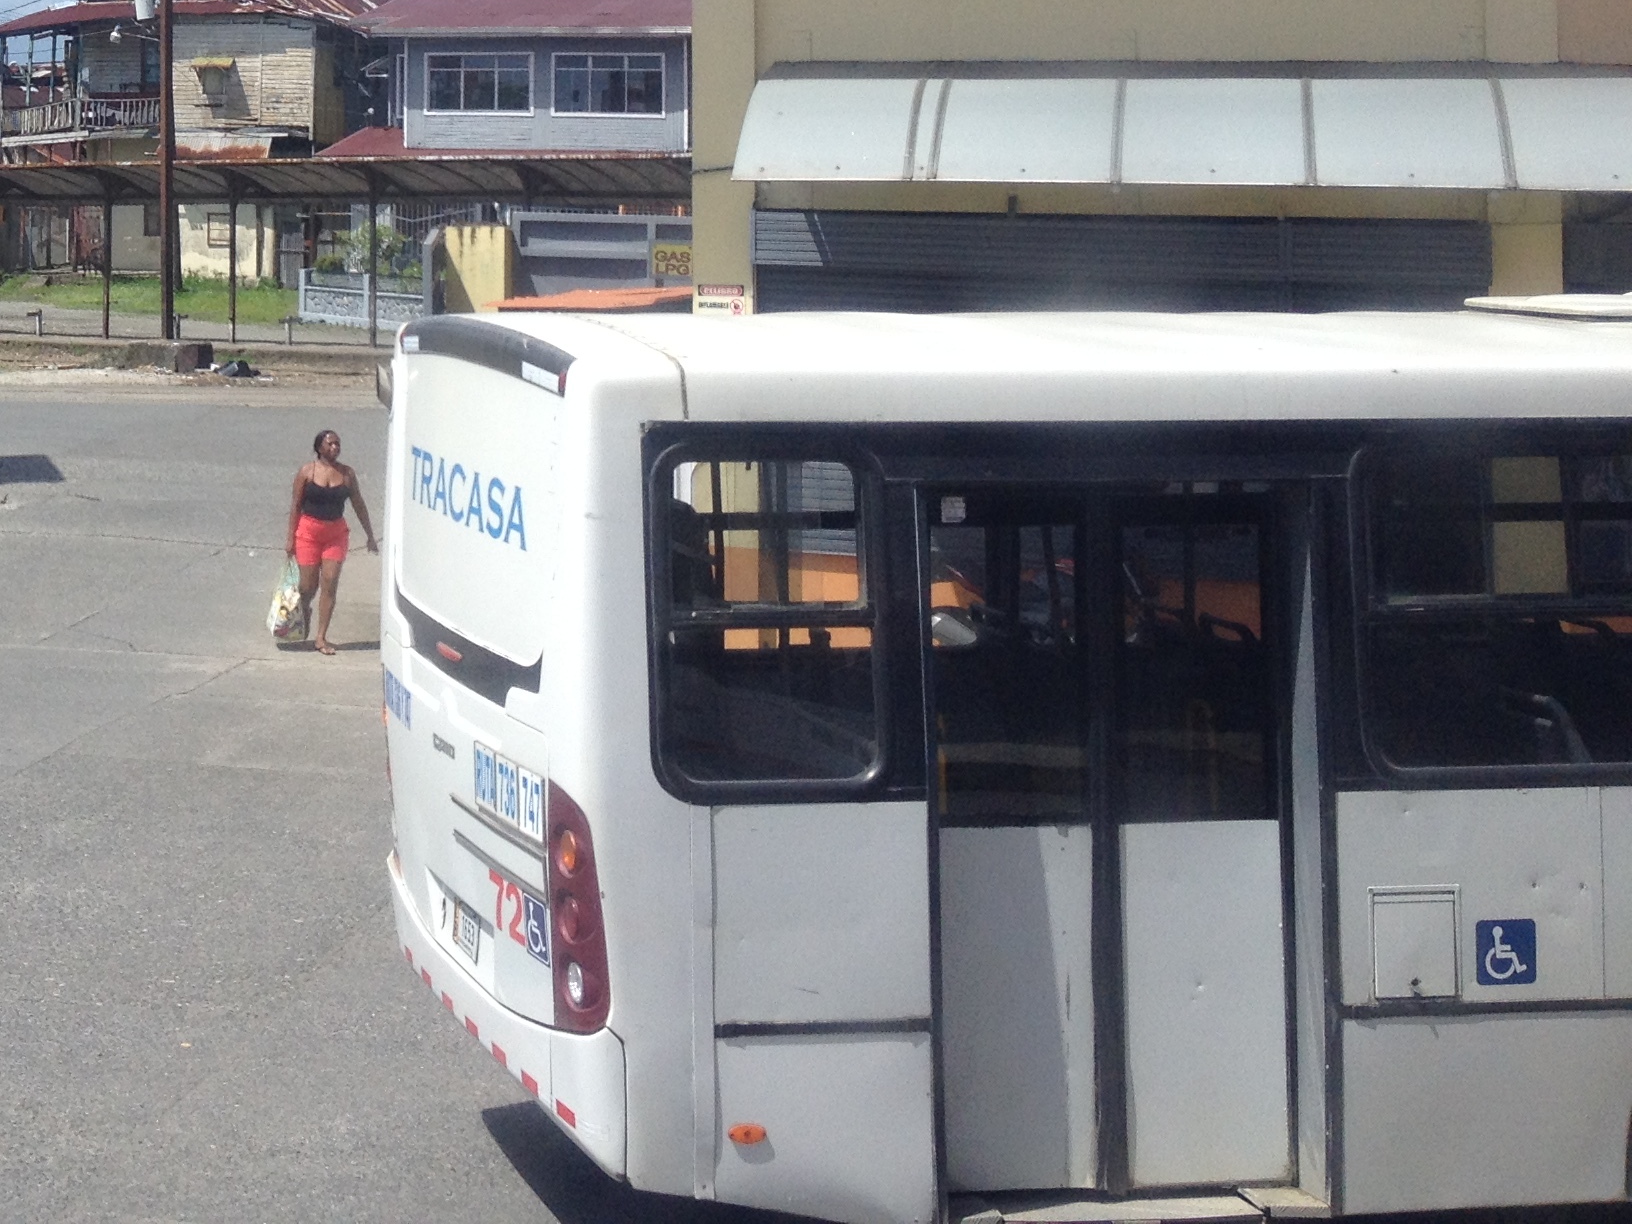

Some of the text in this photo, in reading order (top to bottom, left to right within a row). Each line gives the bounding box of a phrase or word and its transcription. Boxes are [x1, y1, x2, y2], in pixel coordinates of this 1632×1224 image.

[654, 250, 691, 263] GAS
[655, 263, 690, 275] LPG
[411, 444, 528, 552] TRACASA
[488, 867, 526, 947] 72
